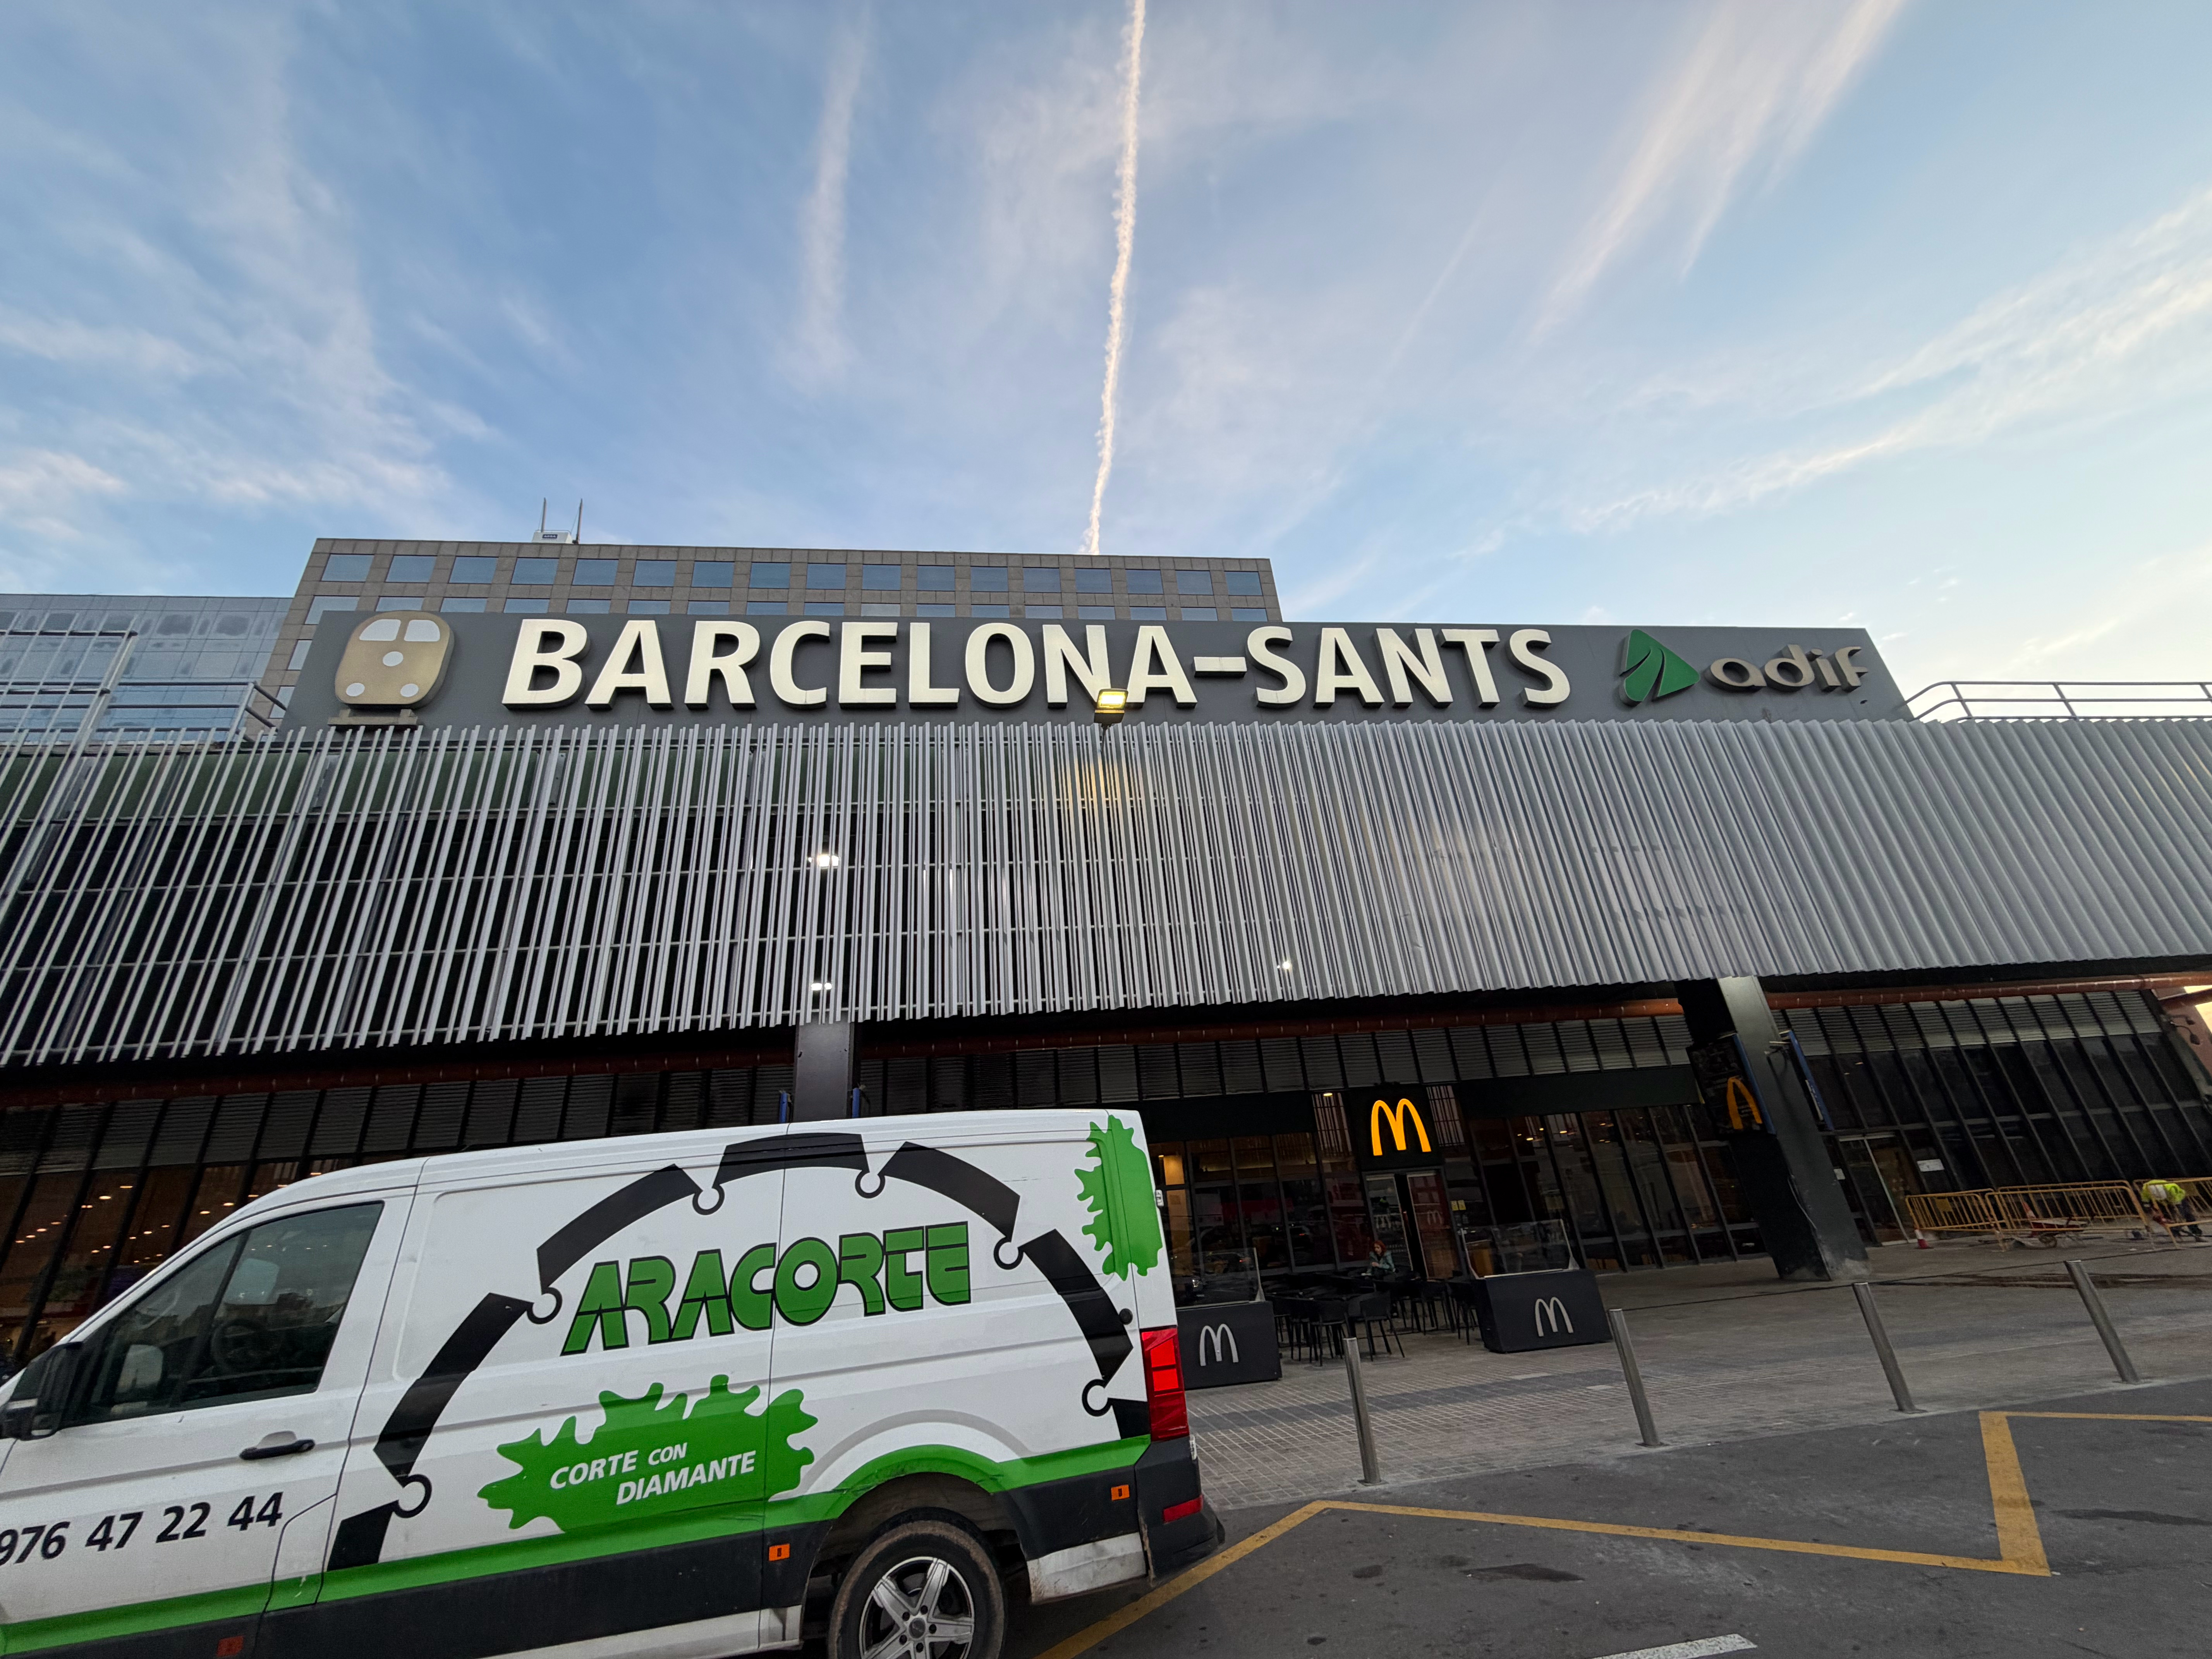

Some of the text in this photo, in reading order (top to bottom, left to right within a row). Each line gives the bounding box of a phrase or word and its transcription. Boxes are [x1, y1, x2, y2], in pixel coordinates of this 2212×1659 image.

[502, 618, 1571, 710] BARCELONA-SANTS
[1705, 644, 1868, 692] adif
[560, 1221, 971, 1357] ARACORTE
[550, 1443, 687, 1489] CORTE CON
[617, 1451, 756, 1505] DIAMANTE
[0, 1492, 283, 1566] 976 47 22 44
